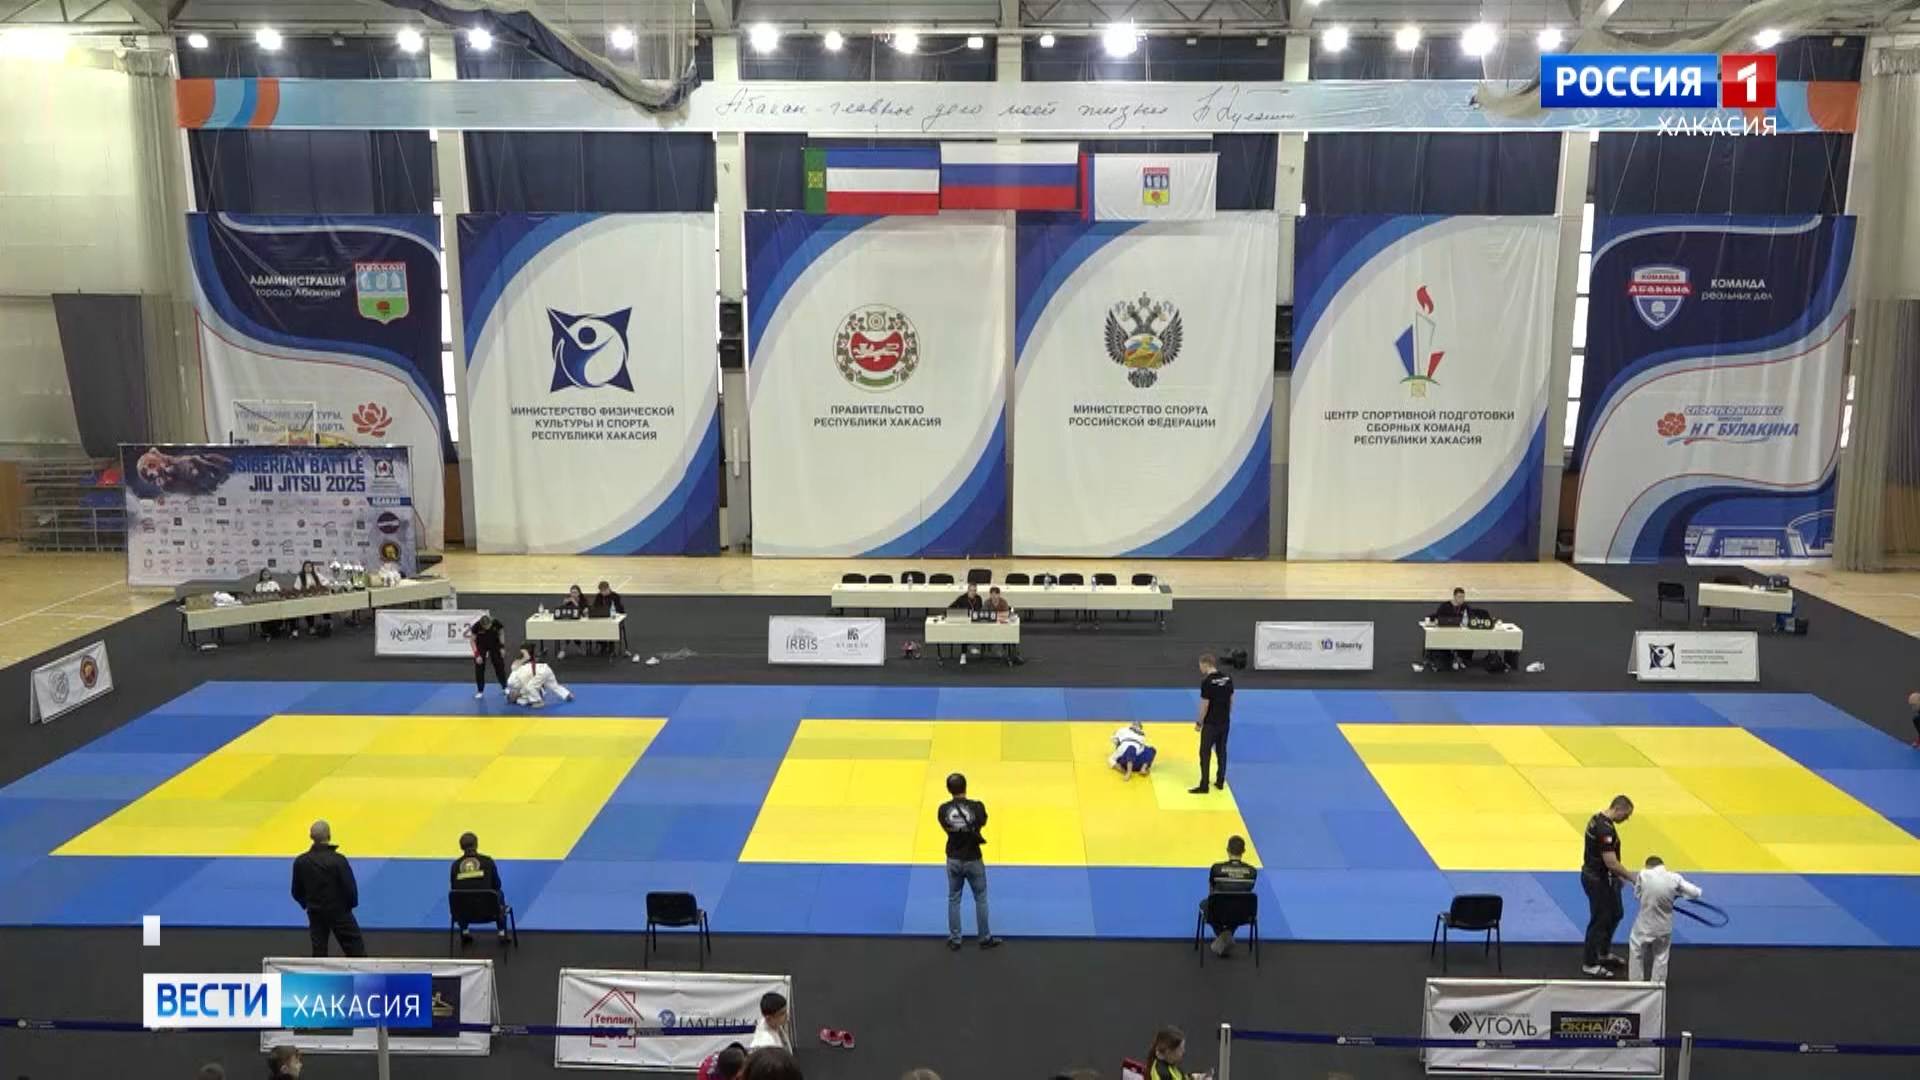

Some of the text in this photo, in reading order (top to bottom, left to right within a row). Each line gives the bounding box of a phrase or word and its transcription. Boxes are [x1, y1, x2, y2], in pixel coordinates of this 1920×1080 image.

[250, 275, 346, 286] АДМИНИСТРАЦИЯ
[1711, 278, 1766, 289] КОМАНДА
[1628, 284, 1690, 295] АБАКАНА
[511, 405, 675, 416] МИНИСТЕРСТВО ФИЗИЧЕСКОЙ
[830, 404, 925, 414] ПРАВИТЕЛЬСТВО
[1073, 404, 1209, 415] МИНИСТЕРСТВО СПОРТА
[1324, 409, 1515, 421] ЦЕНТР СПОРТИВНОЙ ПОДГОТОВКИ
[535, 419, 650, 428] КУЛЬТУРЫ И СПОРТА
[813, 417, 942, 427] РЕСПУБЛИКИ ХАКАСИЯ
[1068, 416, 1216, 428] РОССИЙСКОЙ ФЕДЕРАЦИИ
[1366, 423, 1471, 434] СБОРНЫХ КОМАНД
[1717, 423, 1800, 437] БУЛАКИНА
[531, 431, 657, 441] РЕСПУБЛИКИ ХАКАСИЯ
[1353, 435, 1482, 445] РЕСПУБЛИКИ ХАКАСИЯ
[237, 455, 365, 474] SIBERIAN BATTLE
[249, 475, 273, 492] JIU
[278, 475, 321, 492] JITSU
[325, 475, 366, 492] 2025
[785, 638, 819, 650] IRBIS
[1473, 1015, 1538, 1037] УГОЛЬ
